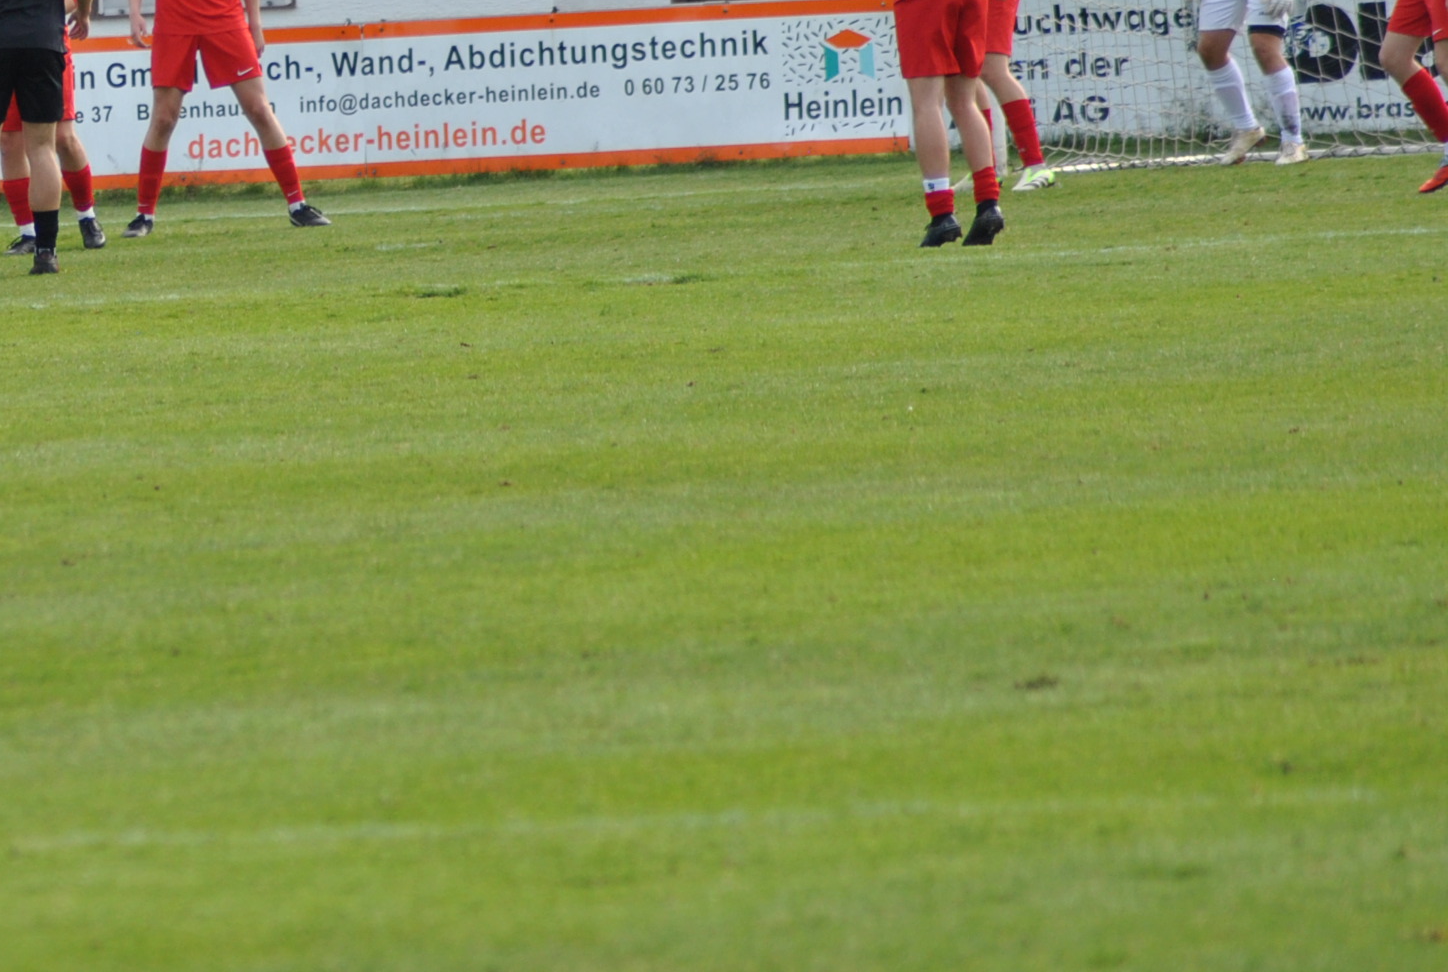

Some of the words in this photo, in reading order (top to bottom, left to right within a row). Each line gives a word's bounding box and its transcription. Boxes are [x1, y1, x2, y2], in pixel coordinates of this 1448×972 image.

[1014, 4, 1200, 36] uchtwage
[106, 59, 198, 89] Gm
[331, 48, 434, 77] Wand-,
[444, 30, 769, 72] Abdichtungstechnik
[1065, 51, 1129, 78] der
[91, 105, 113, 123] 37
[137, 101, 276, 121] Benhau
[300, 81, 601, 115] info@dachdecker-heinlein.de
[624, 79, 635, 96] 0
[642, 78, 664, 95] 60
[672, 76, 695, 93] 73
[714, 74, 739, 92] 25
[746, 72, 771, 90] 76
[784, 88, 902, 121] Heinlein
[1053, 95, 1110, 124] AG
[1300, 97, 1415, 121] ww.bras
[188, 119, 546, 160] dachecker-heinlein.de
